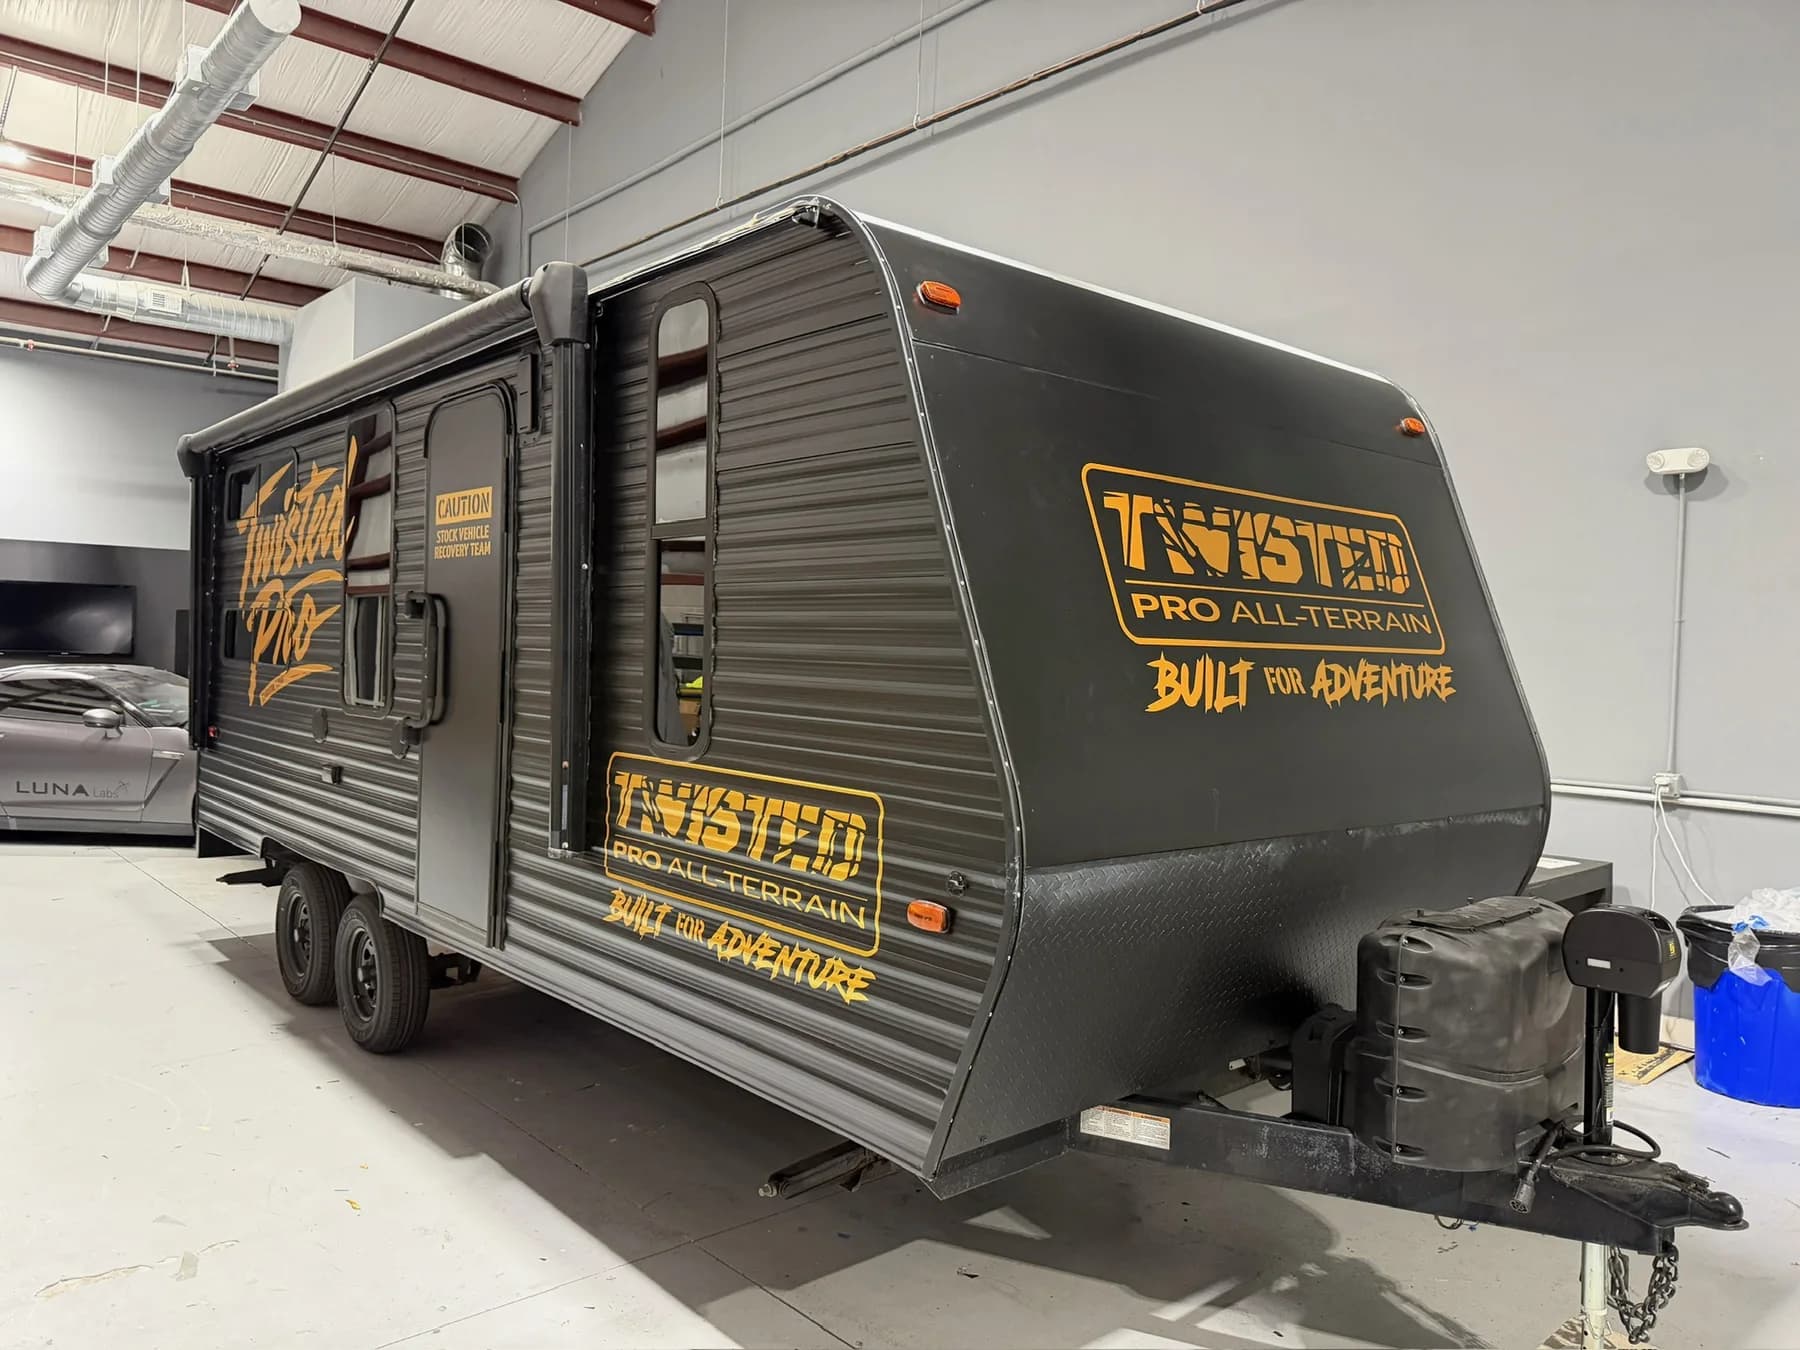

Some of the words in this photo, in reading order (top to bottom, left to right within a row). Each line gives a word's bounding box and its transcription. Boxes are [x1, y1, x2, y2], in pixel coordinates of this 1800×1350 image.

[237, 435, 358, 617] Twisted
[436, 528, 458, 544] STOCK
[459, 525, 489, 541] VEHICLE
[438, 492, 489, 519] CAUTION
[1103, 491, 1411, 594] TWISTED
[434, 543, 469, 560] RECOVERY
[470, 541, 491, 556] TEAM
[247, 570, 343, 706] Pro
[1131, 593, 1220, 622] PRO
[1231, 600, 1433, 634] ALL-TERRAIN
[1145, 651, 1256, 713] BUILT
[1263, 665, 1306, 696] FOR
[1311, 658, 1457, 708] ADVENTURE
[16, 781, 90, 797] LUNA
[93, 786, 119, 799] Labs
[614, 771, 866, 882] TWISTED
[613, 841, 661, 870] PRO
[668, 856, 866, 929] ALL-TERRAIN
[602, 888, 673, 941] BUILT
[675, 911, 705, 944] FOR
[707, 921, 877, 1005] ADVENTURE
